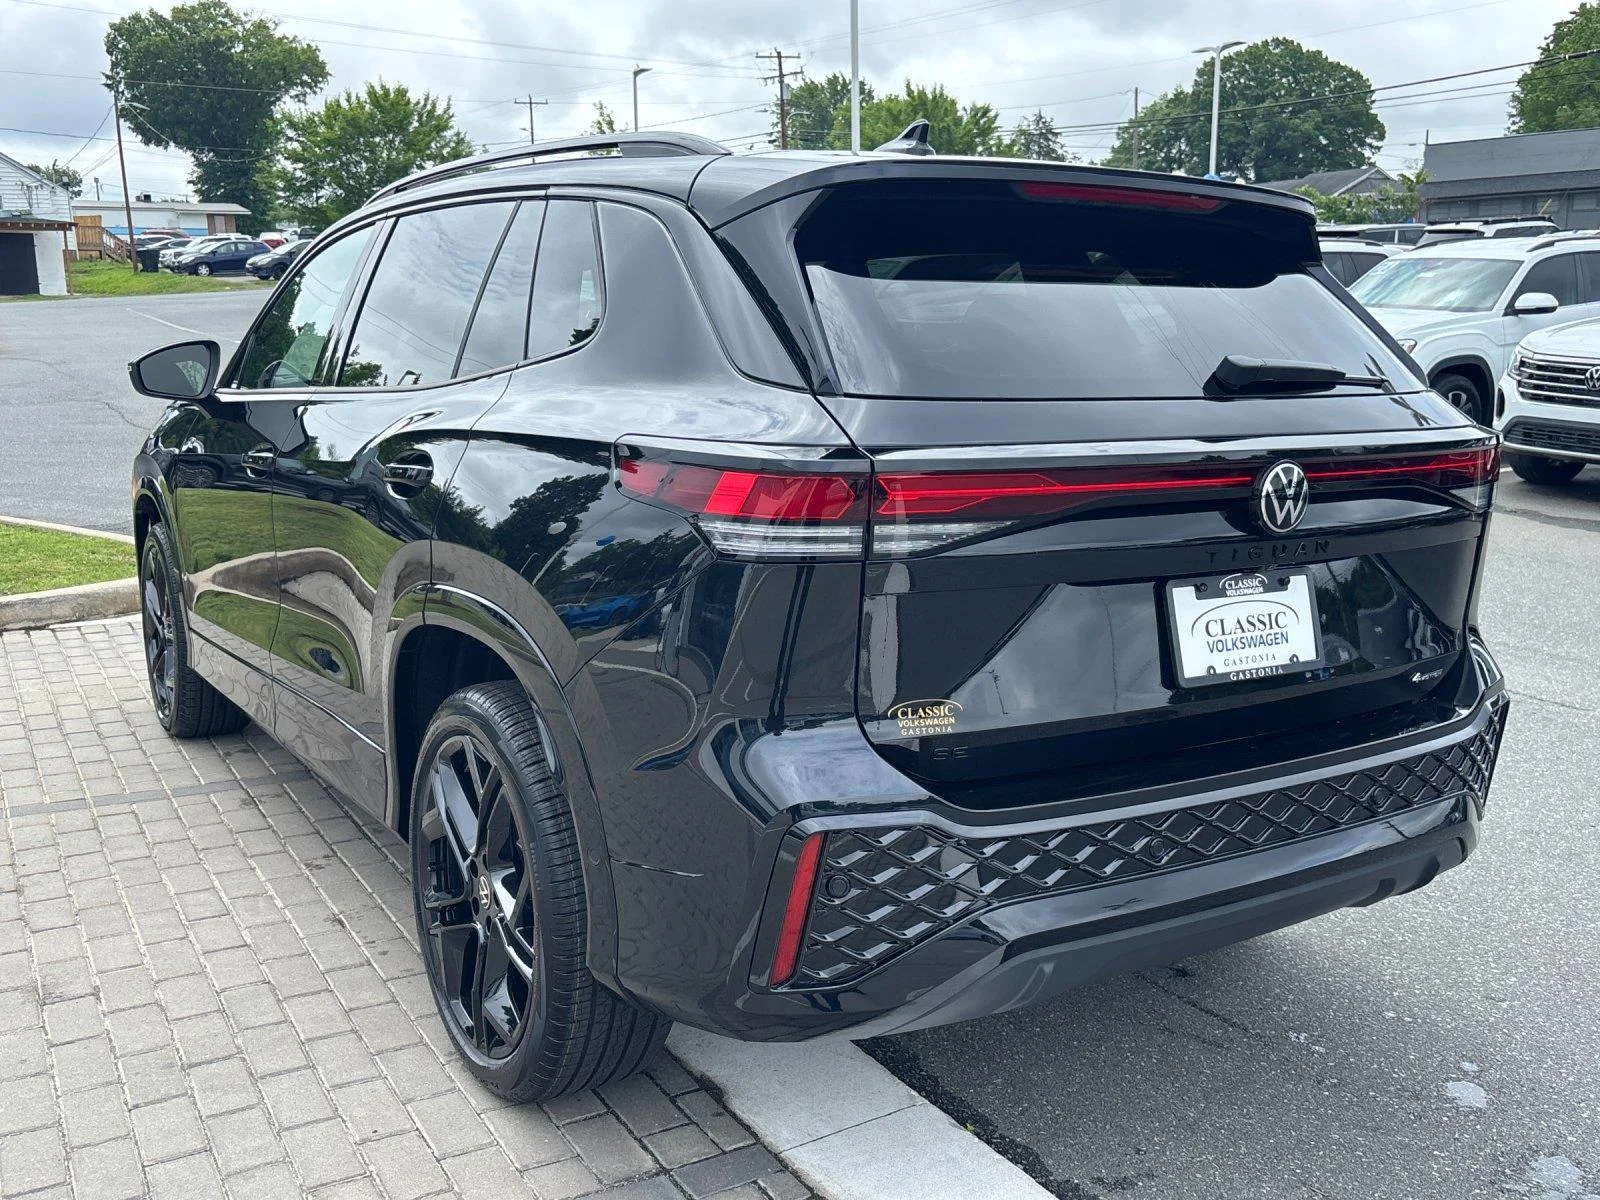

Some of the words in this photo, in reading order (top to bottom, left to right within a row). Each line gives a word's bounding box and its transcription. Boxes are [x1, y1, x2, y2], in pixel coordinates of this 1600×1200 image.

[1261, 463, 1307, 532] VW
[1207, 540, 1329, 563] TIGUAN
[1225, 578, 1262, 588] CLASSIC
[1226, 587, 1263, 597] VOLKSWAGEN
[1205, 611, 1287, 638] CLASSIC
[1207, 631, 1289, 653] VOLKSWAGEN
[1224, 653, 1276, 667] GASTONIA
[1230, 667, 1284, 681] GASTONIA
[897, 705, 954, 719] CLASSIC
[898, 716, 955, 727] VOLKSWAGEN
[901, 726, 953, 735] GASTONIA
[933, 746, 968, 760] SE
